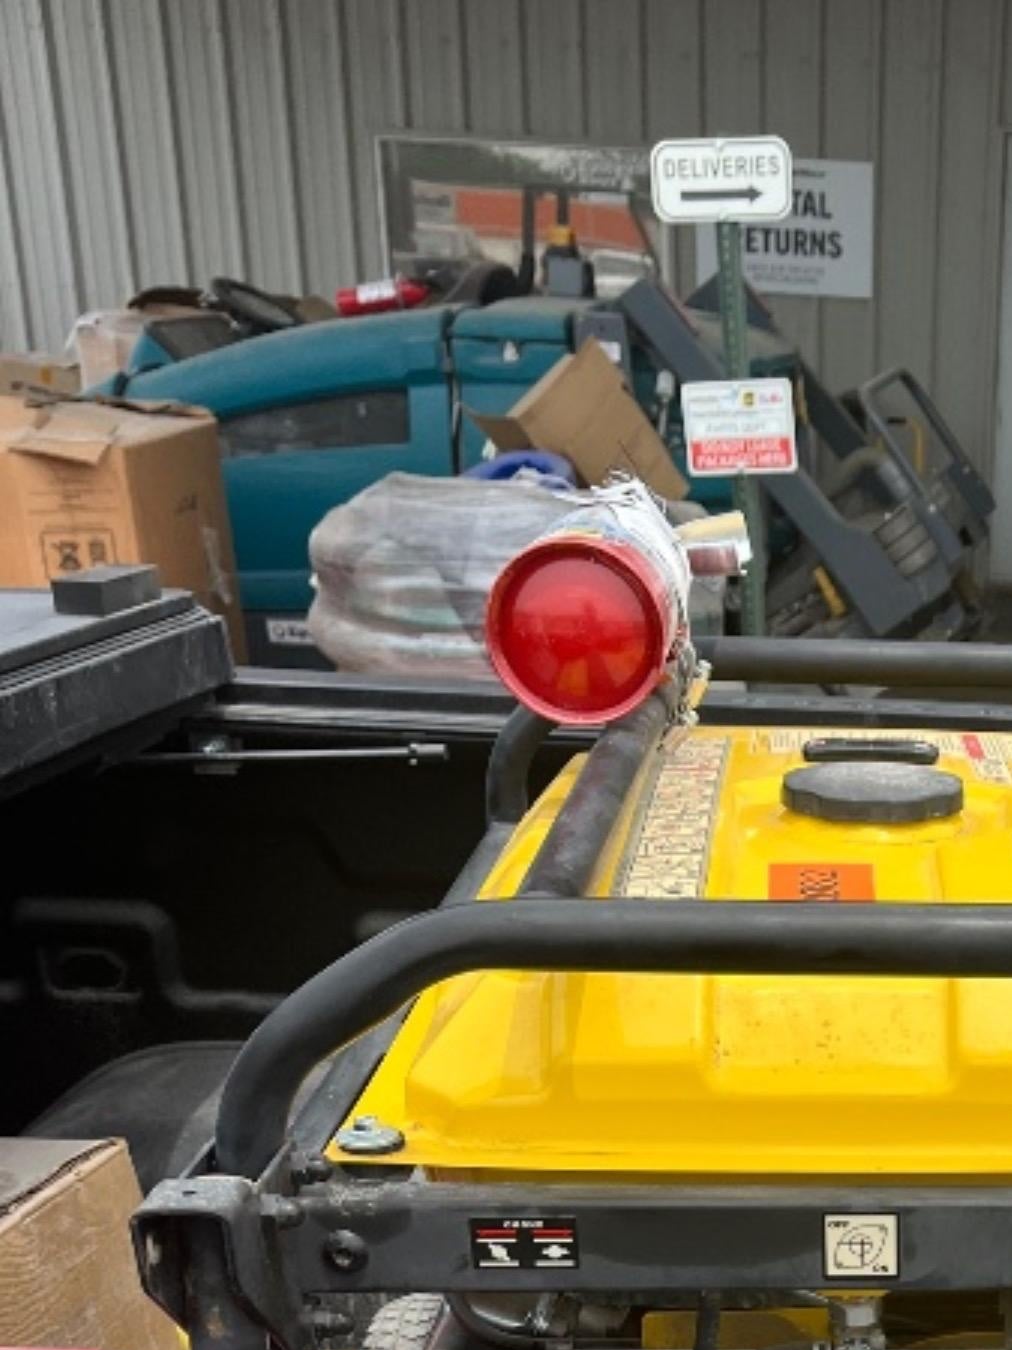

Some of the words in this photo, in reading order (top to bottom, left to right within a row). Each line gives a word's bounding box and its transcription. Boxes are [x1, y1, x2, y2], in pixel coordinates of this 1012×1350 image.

[662, 155, 781, 179] DELIVERIES
[792, 188, 833, 220] TAL
[745, 226, 843, 260] ETURNS
